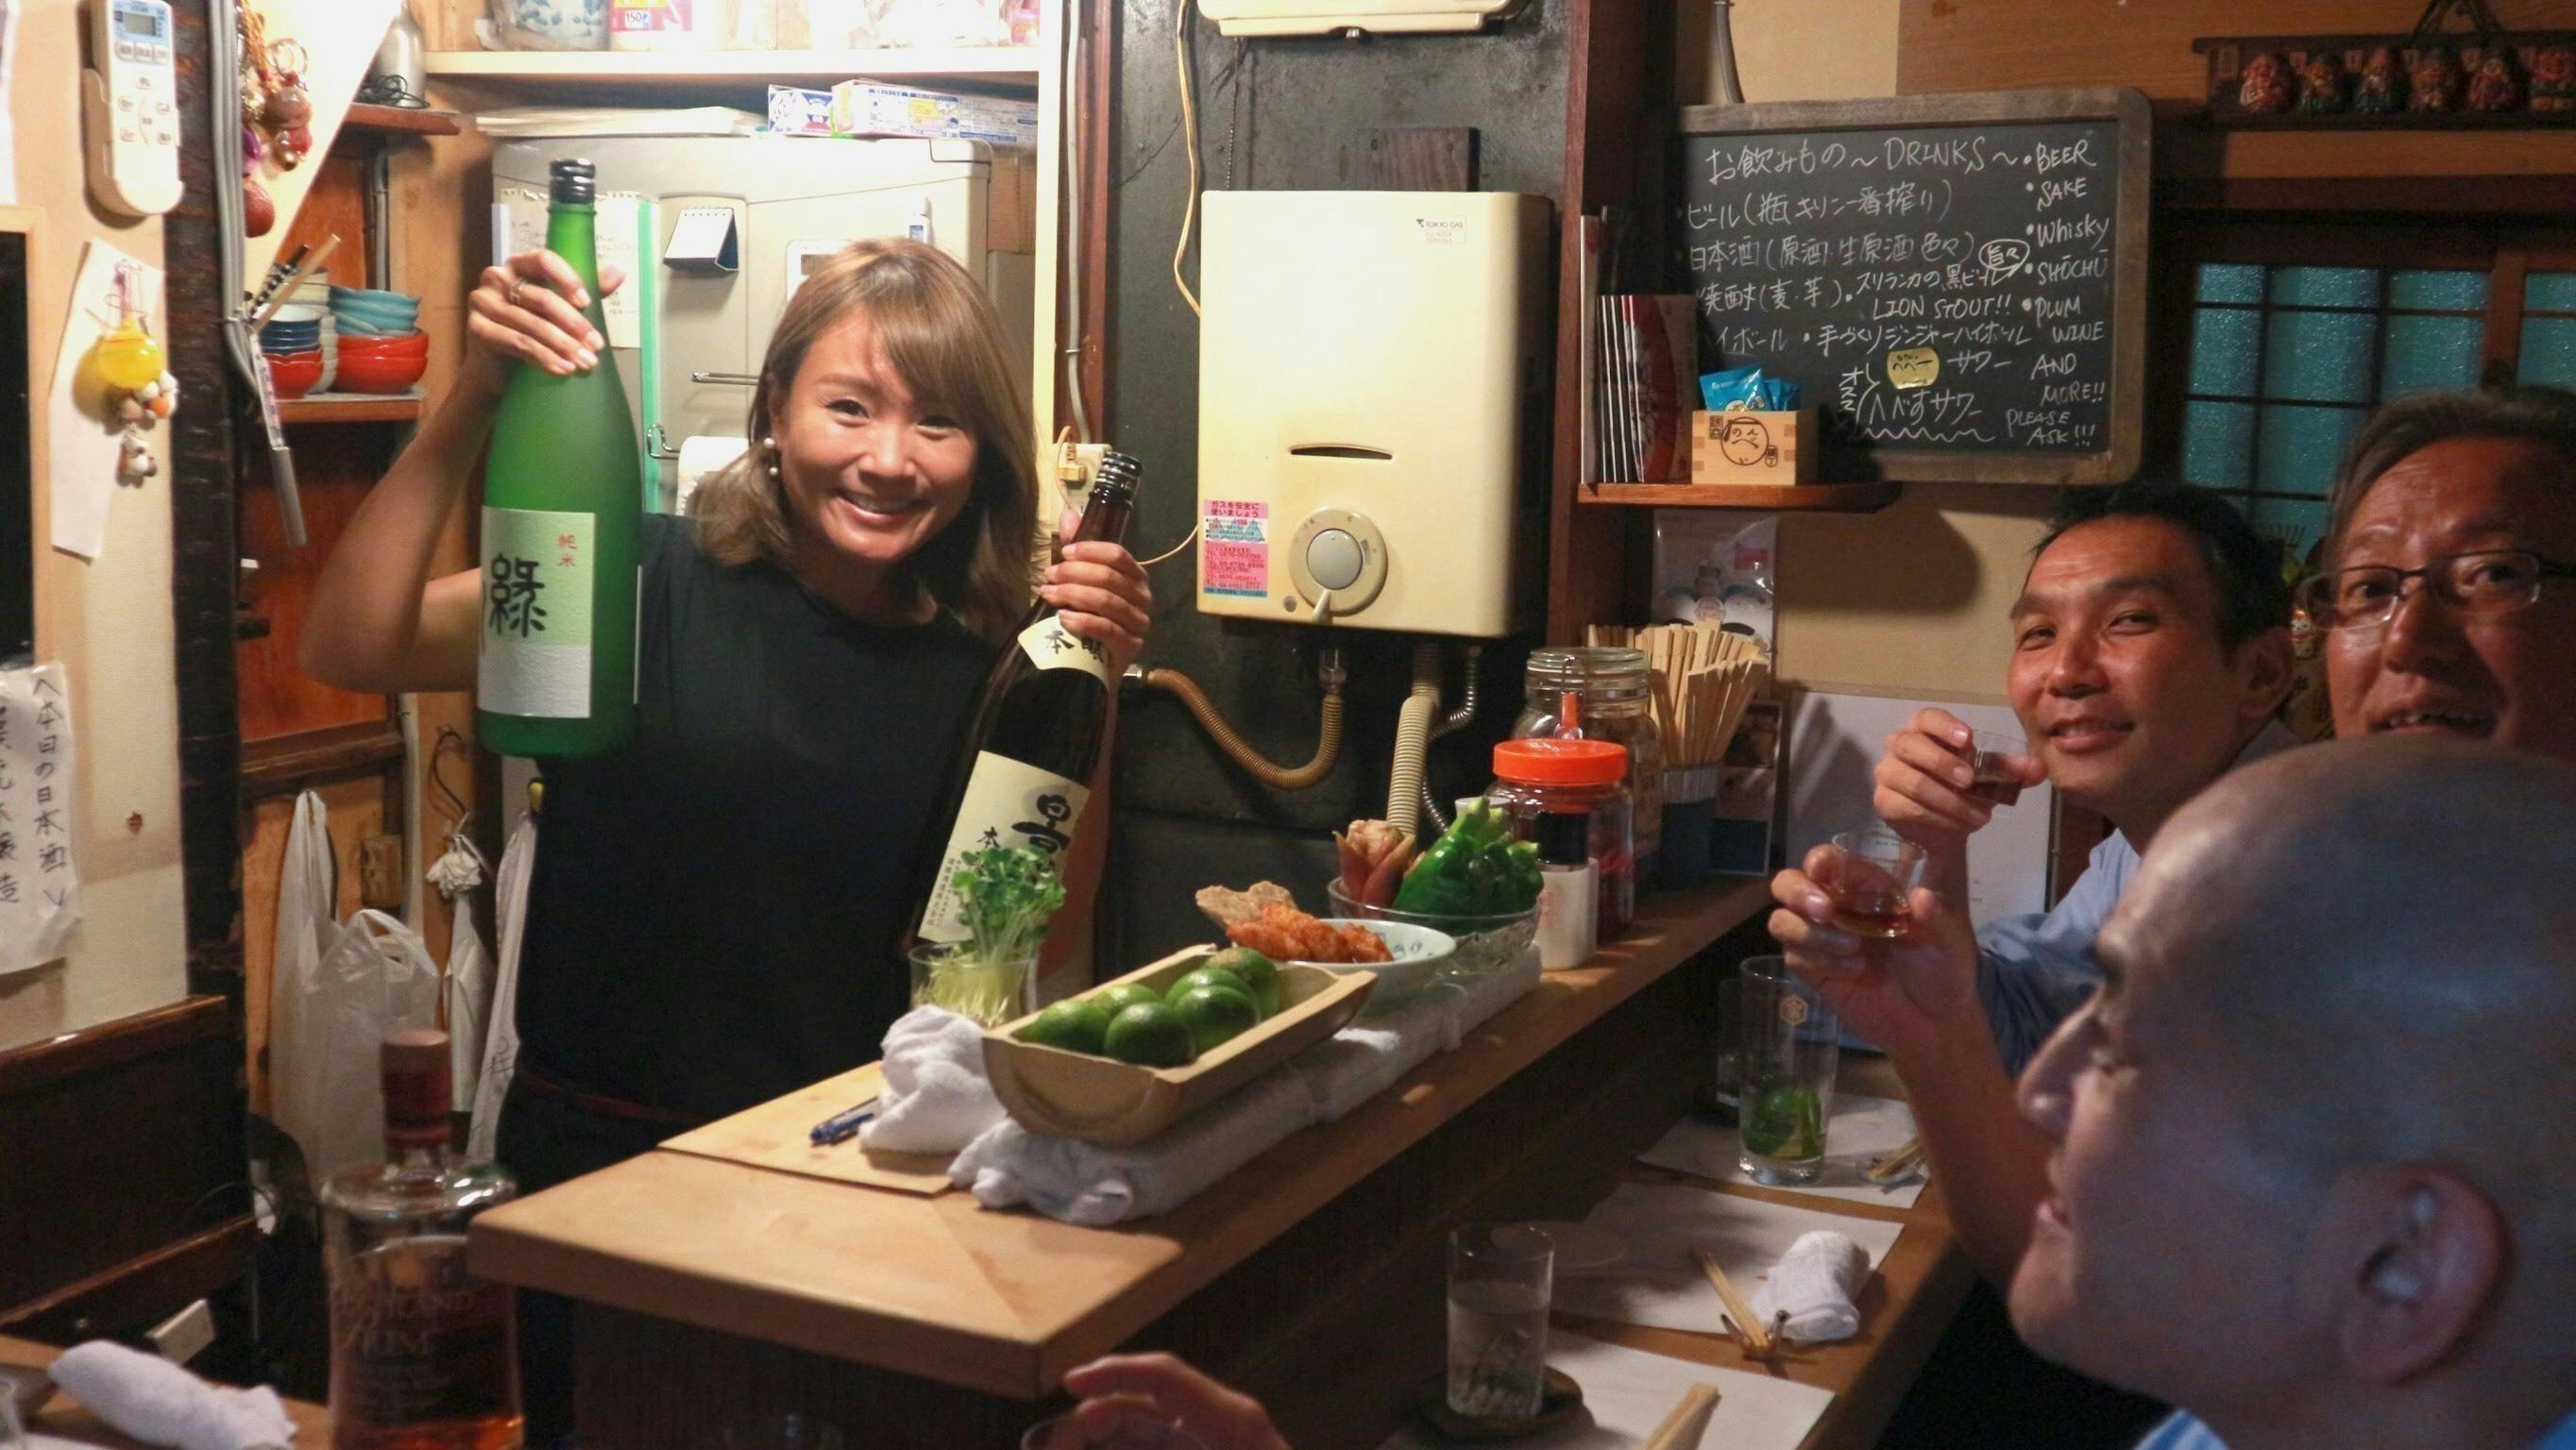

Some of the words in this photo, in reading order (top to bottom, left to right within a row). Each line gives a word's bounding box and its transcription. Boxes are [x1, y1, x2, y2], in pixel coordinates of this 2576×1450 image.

[1885, 135, 1987, 174] DRINKS
[2036, 139, 2097, 175] BEER
[2037, 177, 2088, 211] SAKE
[2037, 213, 2110, 250] Whisky
[1873, 295, 1924, 321] LION
[2034, 295, 2081, 328] PLUM
[2051, 322, 2105, 344] WINE
[2031, 353, 2077, 379] AND
[2006, 409, 2071, 438] PLEASE
[557, 533, 577, 567] 純米
